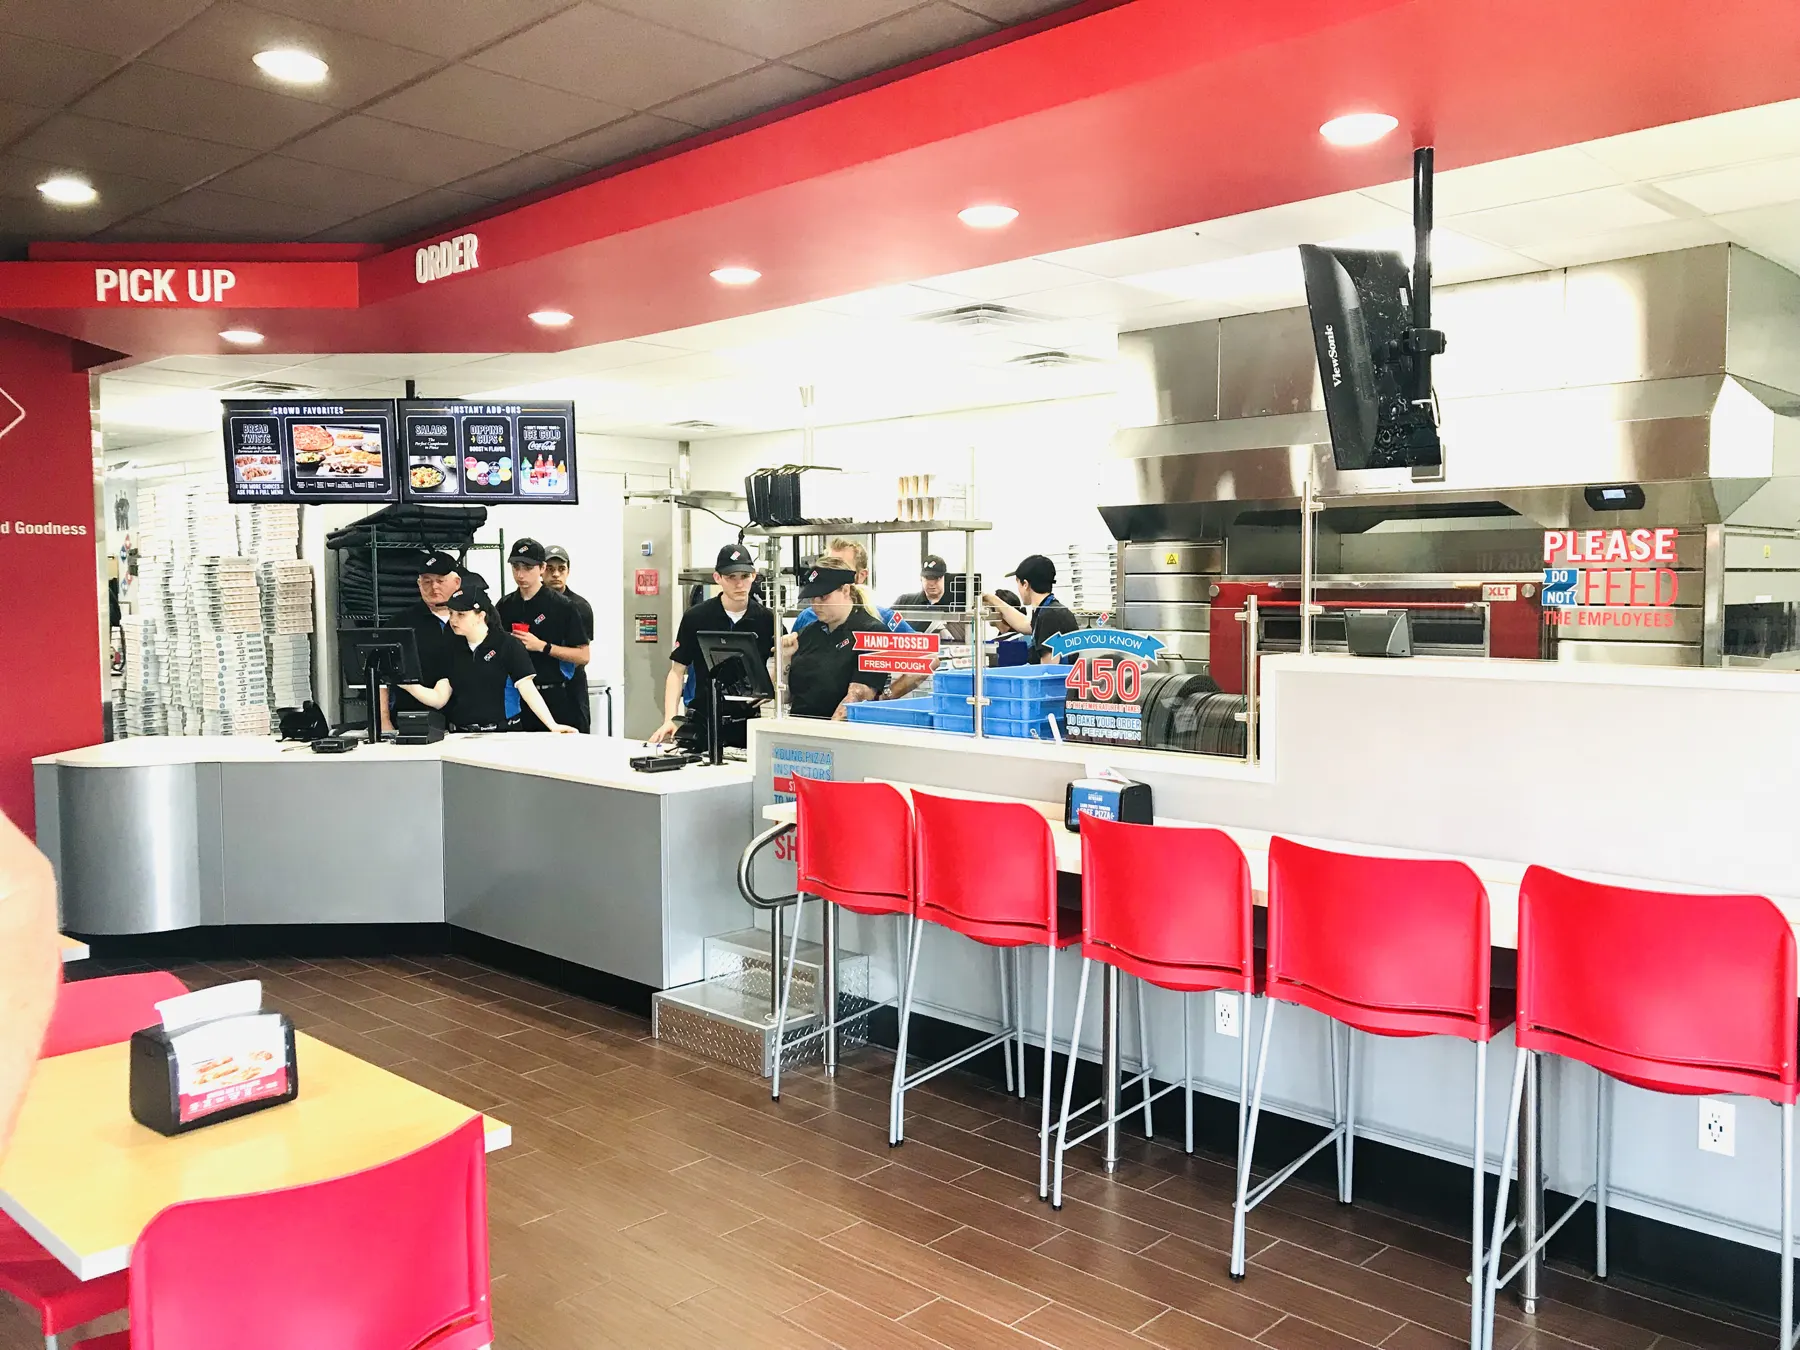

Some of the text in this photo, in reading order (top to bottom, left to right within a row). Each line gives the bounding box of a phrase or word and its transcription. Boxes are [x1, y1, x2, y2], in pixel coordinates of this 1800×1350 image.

[415, 233, 479, 284] ORDER
[95, 269, 237, 303] PICK UP
[1325, 324, 1343, 388] ViewSonic
[272, 406, 344, 414] CROWD FAVORITES
[450, 406, 522, 414] INSTANT ADD-ONS
[243, 424, 268, 434] BREAD
[414, 424, 448, 435] SALADS
[470, 425, 504, 435] DIPPING
[539, 430, 560, 440] COLD
[476, 434, 498, 444] CUPS
[15, 521, 87, 535] Goodness
[1543, 528, 1679, 564] PLEASE
[1551, 570, 1568, 583] DO
[1488, 587, 1511, 596] XLT
[1584, 568, 1679, 607] FEED
[1547, 591, 1573, 604] NOT
[1544, 610, 1571, 626] THE
[1578, 611, 1675, 628] EMPLOYEES
[864, 635, 930, 650] HAND-TOSSED
[1065, 634, 1143, 650] DID YOU KNOW
[864, 660, 926, 672] FRESH DOUGH
[1072, 701, 1082, 710] THE
[1082, 702, 1119, 712] TEMPERATURE
[1125, 704, 1141, 713] TAKES
[1066, 714, 1142, 730] TO BAKE YOUR ORDER
[1066, 726, 1141, 741] TO PERFECTION
[774, 747, 832, 765] YOUNG PIZZA
[774, 764, 831, 780] INSPECTORS
